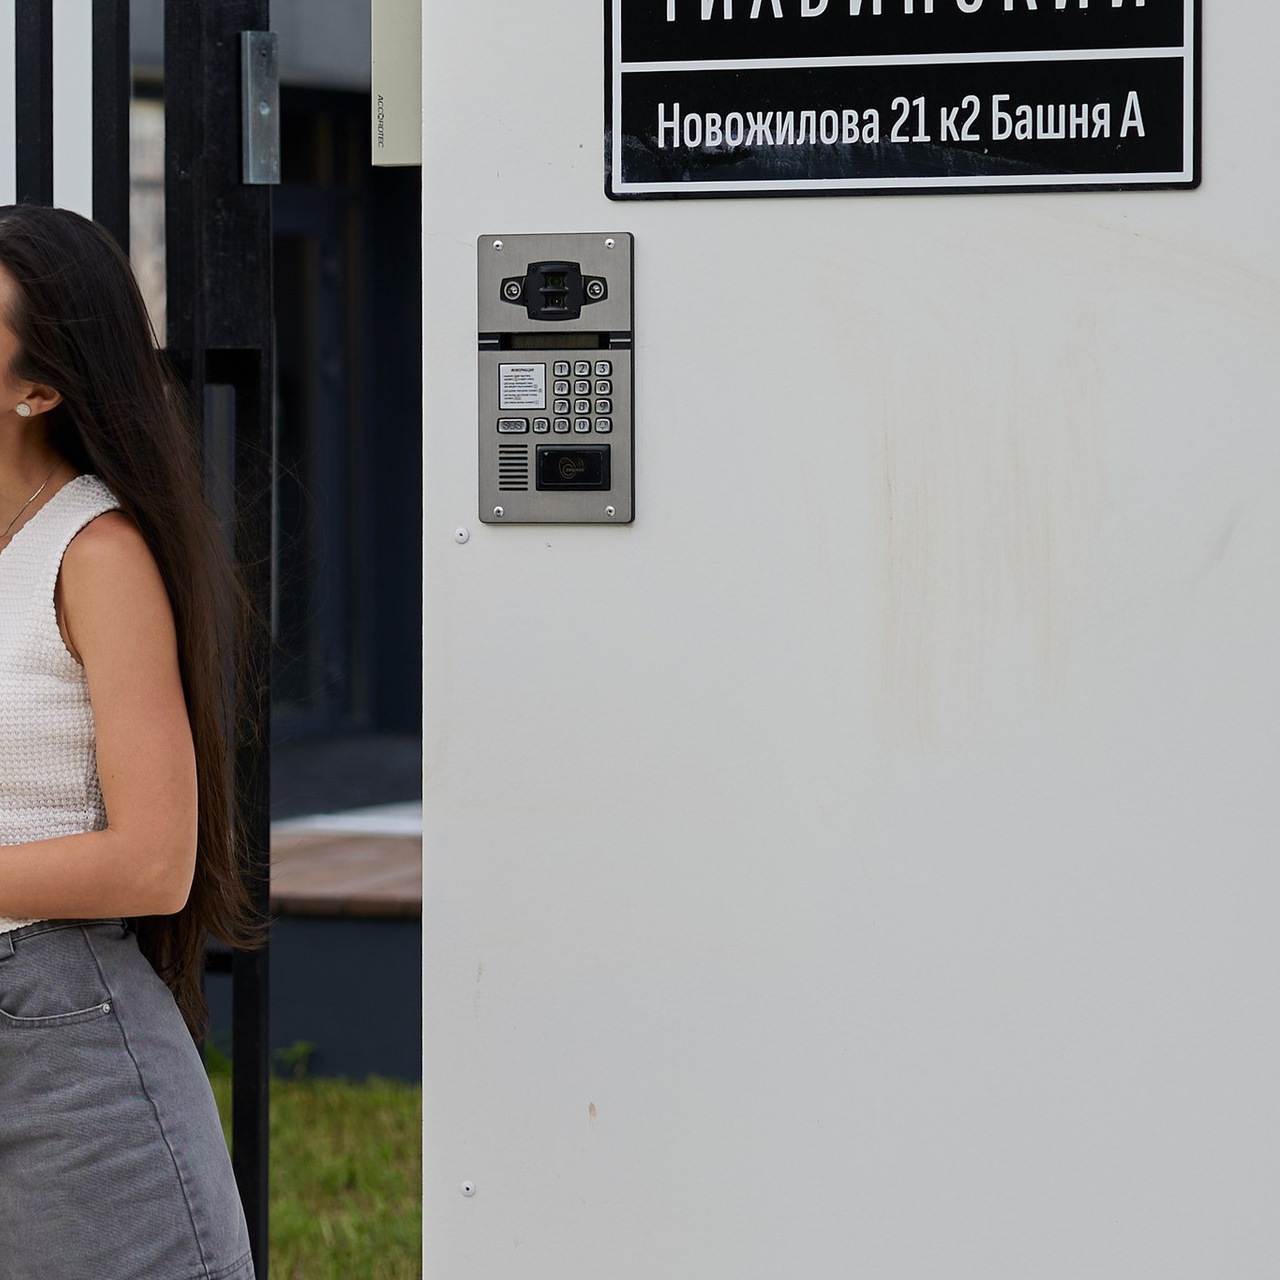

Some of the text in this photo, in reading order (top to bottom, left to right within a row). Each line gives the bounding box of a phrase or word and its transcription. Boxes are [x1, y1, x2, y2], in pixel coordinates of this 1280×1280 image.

[377, 94, 385, 149] ACCORDTEC
[657, 90, 1146, 148] Новожилова 21 к2 Башня А
